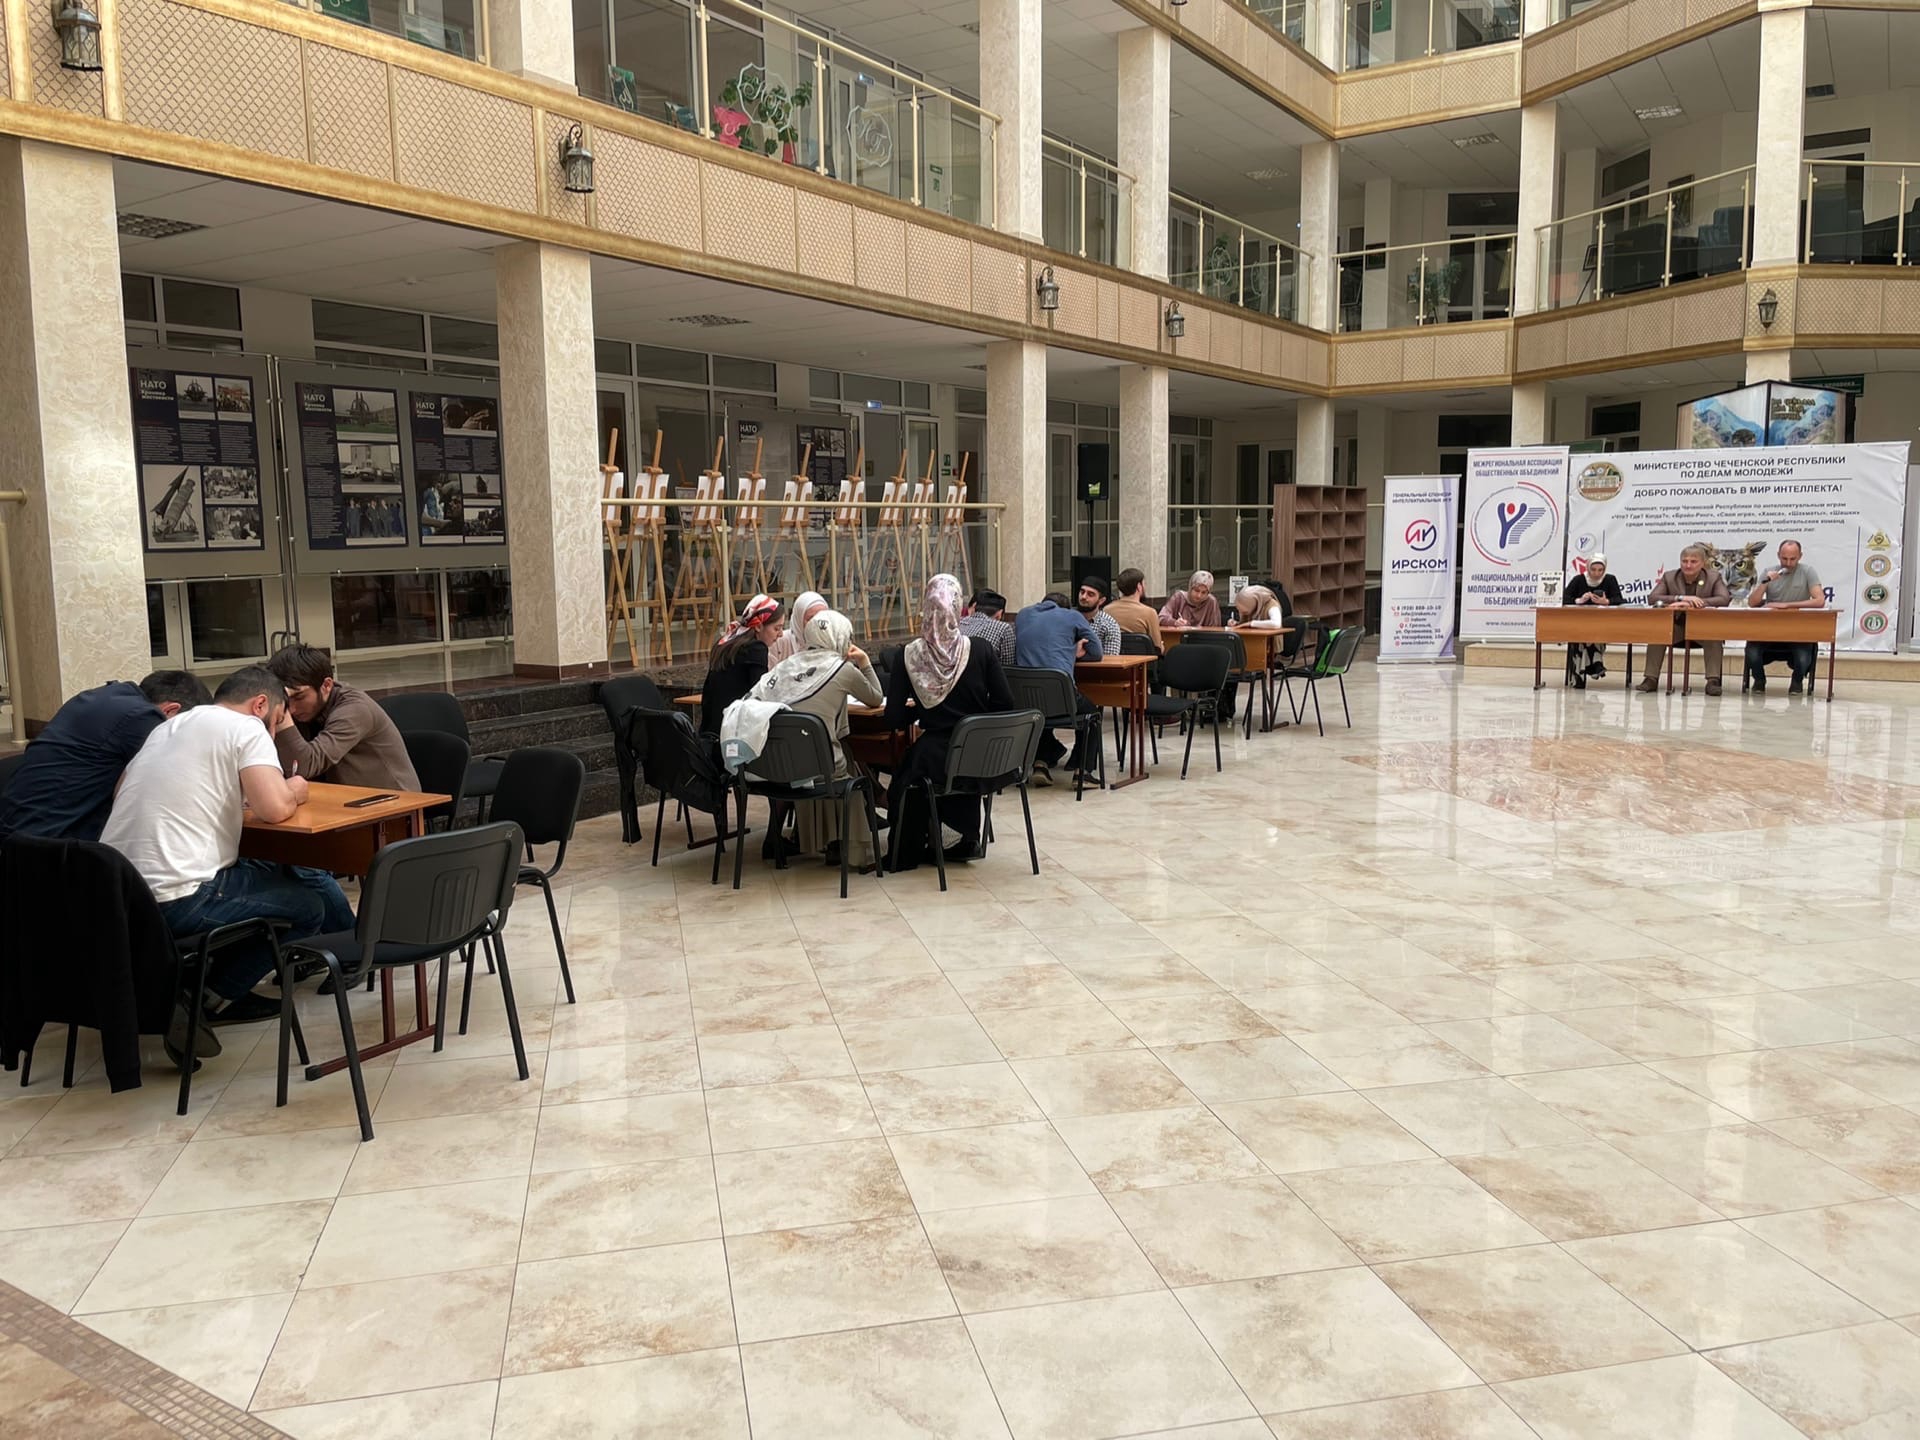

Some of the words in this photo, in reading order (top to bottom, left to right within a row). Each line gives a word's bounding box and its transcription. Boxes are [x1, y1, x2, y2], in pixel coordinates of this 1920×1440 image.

[140, 380, 166, 390] НАТО
[304, 393, 326, 402] НАТО
[416, 401, 435, 410] НАТО
[740, 424, 757, 432] НАТО
[1474, 460, 1526, 468] МЕЖРЕГИОНАЛЬНАЯ
[1527, 458, 1562, 466] АССОЦИАЦИЯ
[1634, 461, 1711, 471] МИНИСТЕРСТВО
[1714, 457, 1774, 467] ЧЕЧЕНСКОЙ
[1778, 456, 1846, 466] РЕСПУБЛИКИ
[1476, 469, 1518, 477] ОБЩЕСТВЕННЫХ
[1520, 468, 1559, 476] ОБЪЕДИНЕНИЙ
[1697, 469, 1731, 479] ДЕЛАМ
[1735, 468, 1793, 477] МОЛОДЕЖИ
[1634, 488, 1667, 498] ДОБРО
[1670, 487, 1737, 496] ПОЖАЛОВАТЬ
[1774, 484, 1843, 493] ИНТЕЛЛЕКТА!
[1392, 559, 1448, 569] ИРСКОМ
[1471, 573, 1530, 582] «НАЦИОНАЛЬНЫЙ
[1468, 585, 1517, 594] МОЛОДЕЖНЫХ
[1518, 585, 1522, 593] И
[1618, 579, 1652, 593] РЭЙН
